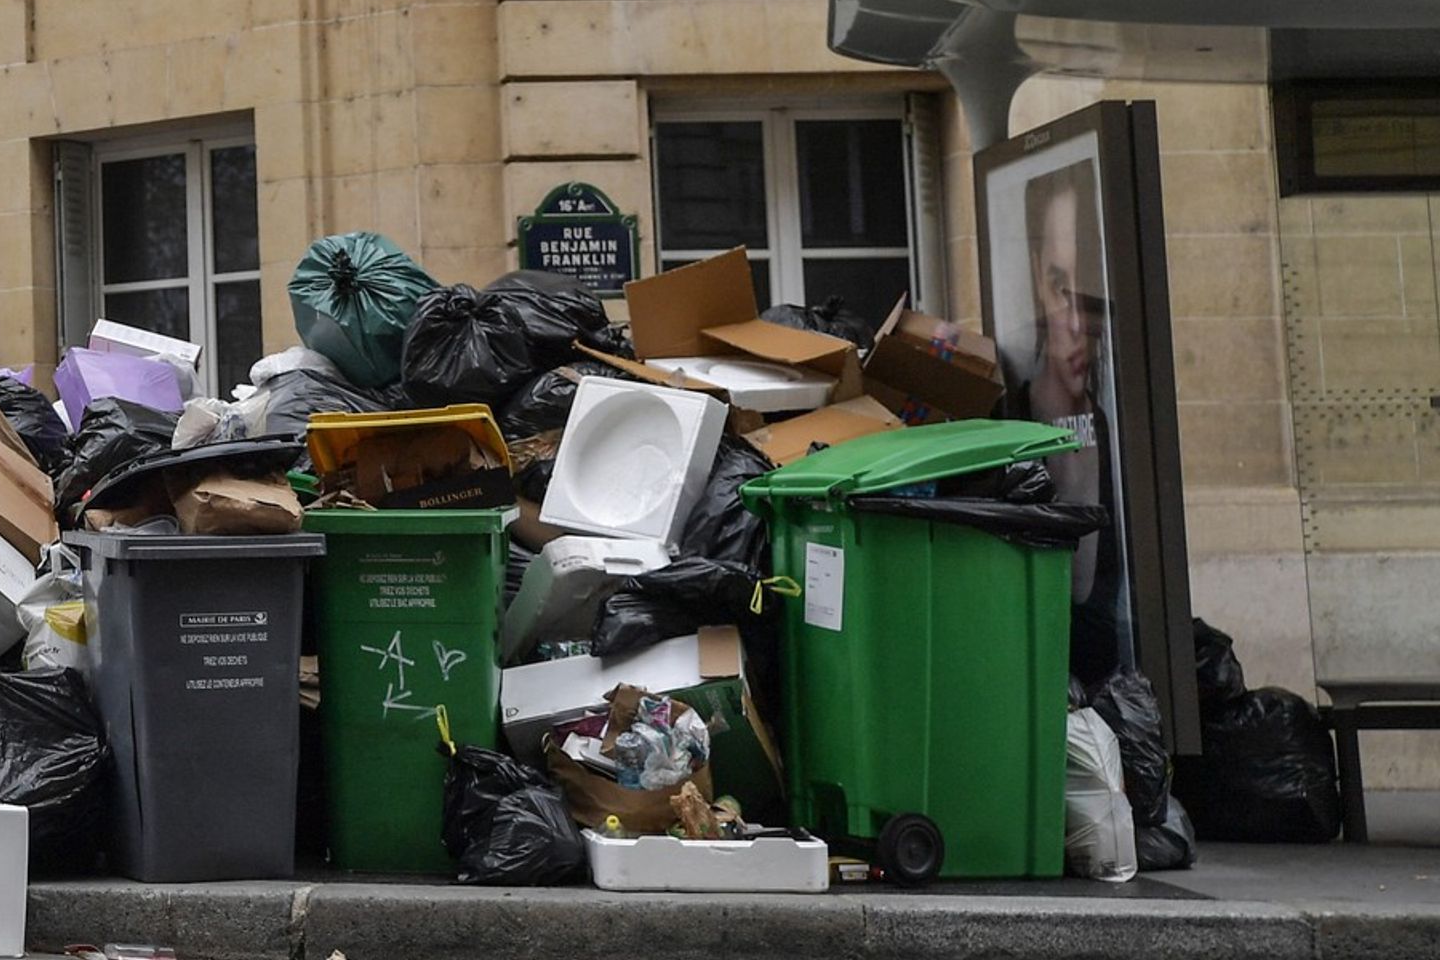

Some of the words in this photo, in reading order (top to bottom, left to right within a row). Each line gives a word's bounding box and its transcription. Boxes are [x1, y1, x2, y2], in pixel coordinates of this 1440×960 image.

[563, 227, 593, 239] RUE
[540, 240, 617, 254] BENJAMIN
[542, 253, 617, 267] FRANKLIN
[418, 487, 483, 508] BOLLINGER
